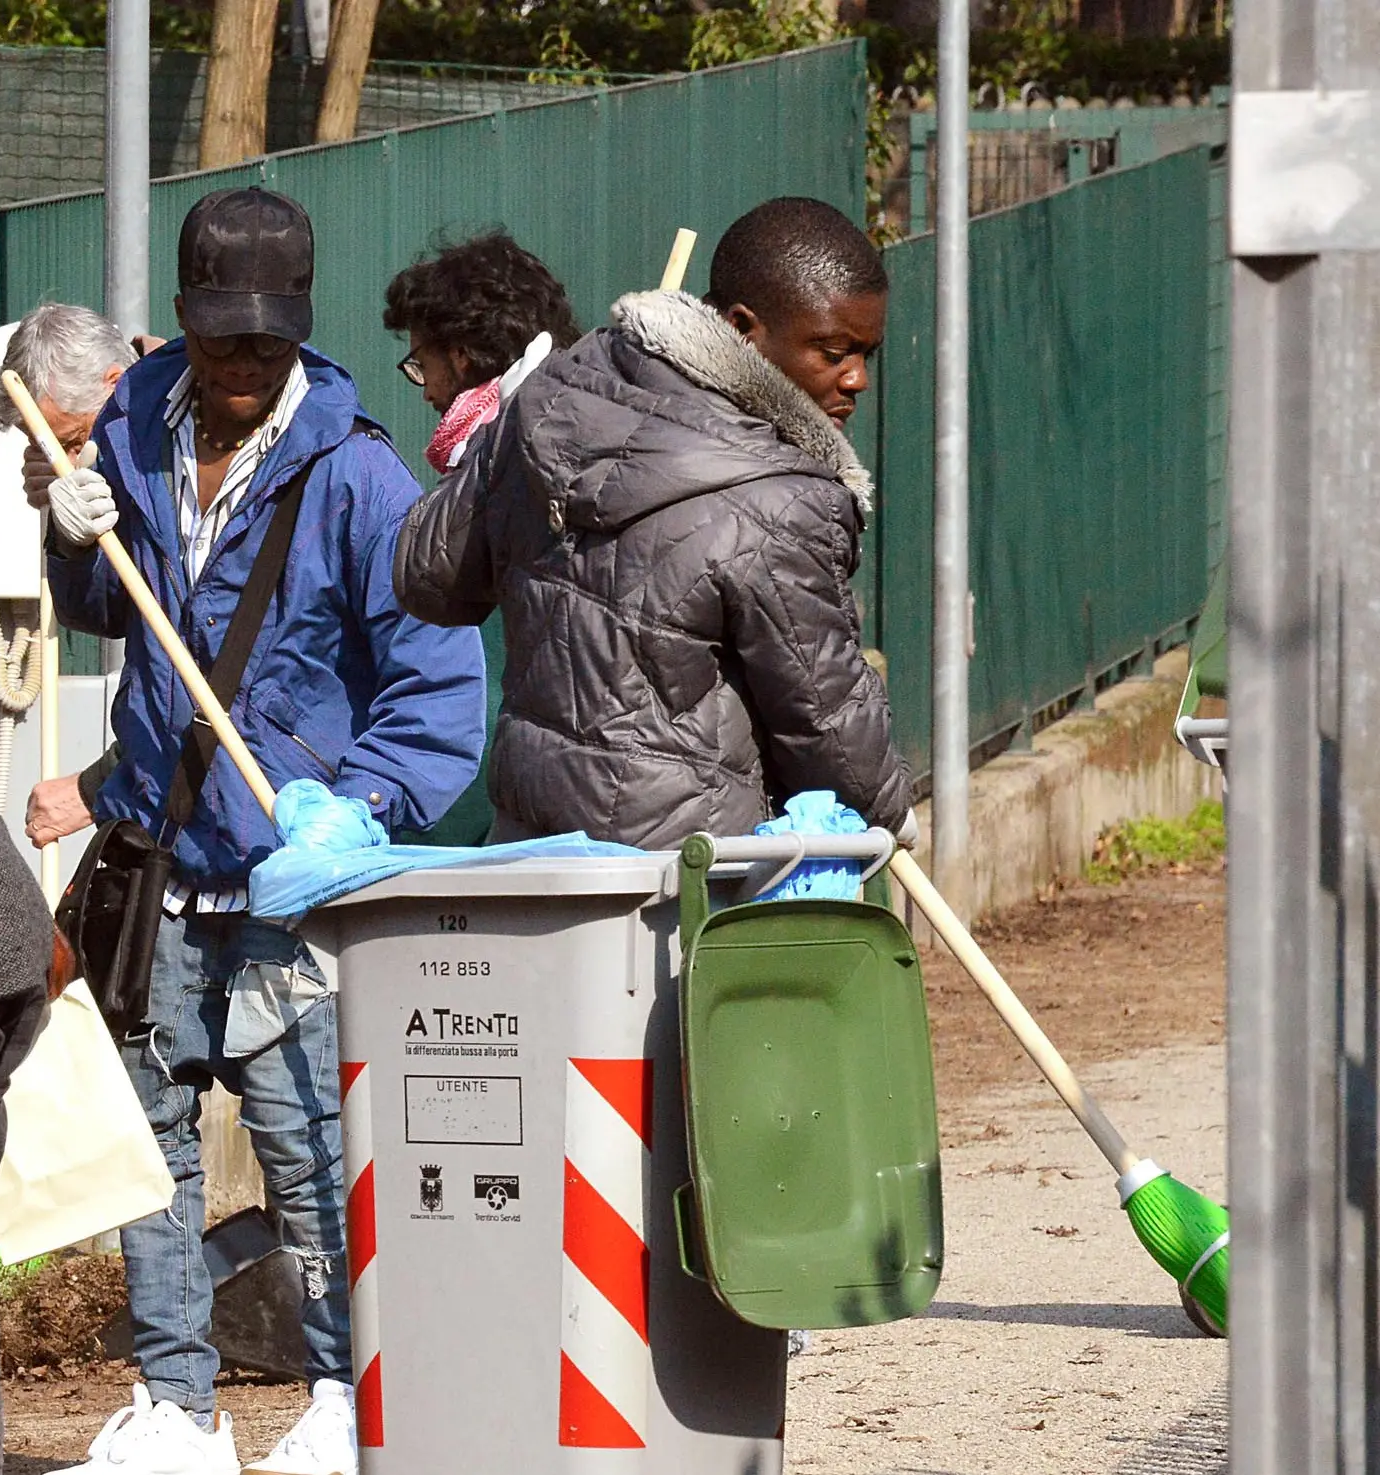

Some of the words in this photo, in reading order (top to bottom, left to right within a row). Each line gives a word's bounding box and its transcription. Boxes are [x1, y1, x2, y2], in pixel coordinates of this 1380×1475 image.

[437, 914, 468, 931] 120
[419, 961, 450, 976] 112
[457, 961, 491, 976] 853
[405, 1008, 428, 1037] A
[432, 1008, 519, 1040] TRENTO
[405, 1045, 412, 1056] la
[413, 1045, 459, 1056] differenziata
[460, 1046, 482, 1057] bussa
[484, 1047, 497, 1057] alla
[498, 1047, 518, 1059] porta
[436, 1080, 488, 1093] UTENTE
[476, 1177, 518, 1185] GRUPPO
[474, 1213, 500, 1222] Trentino
